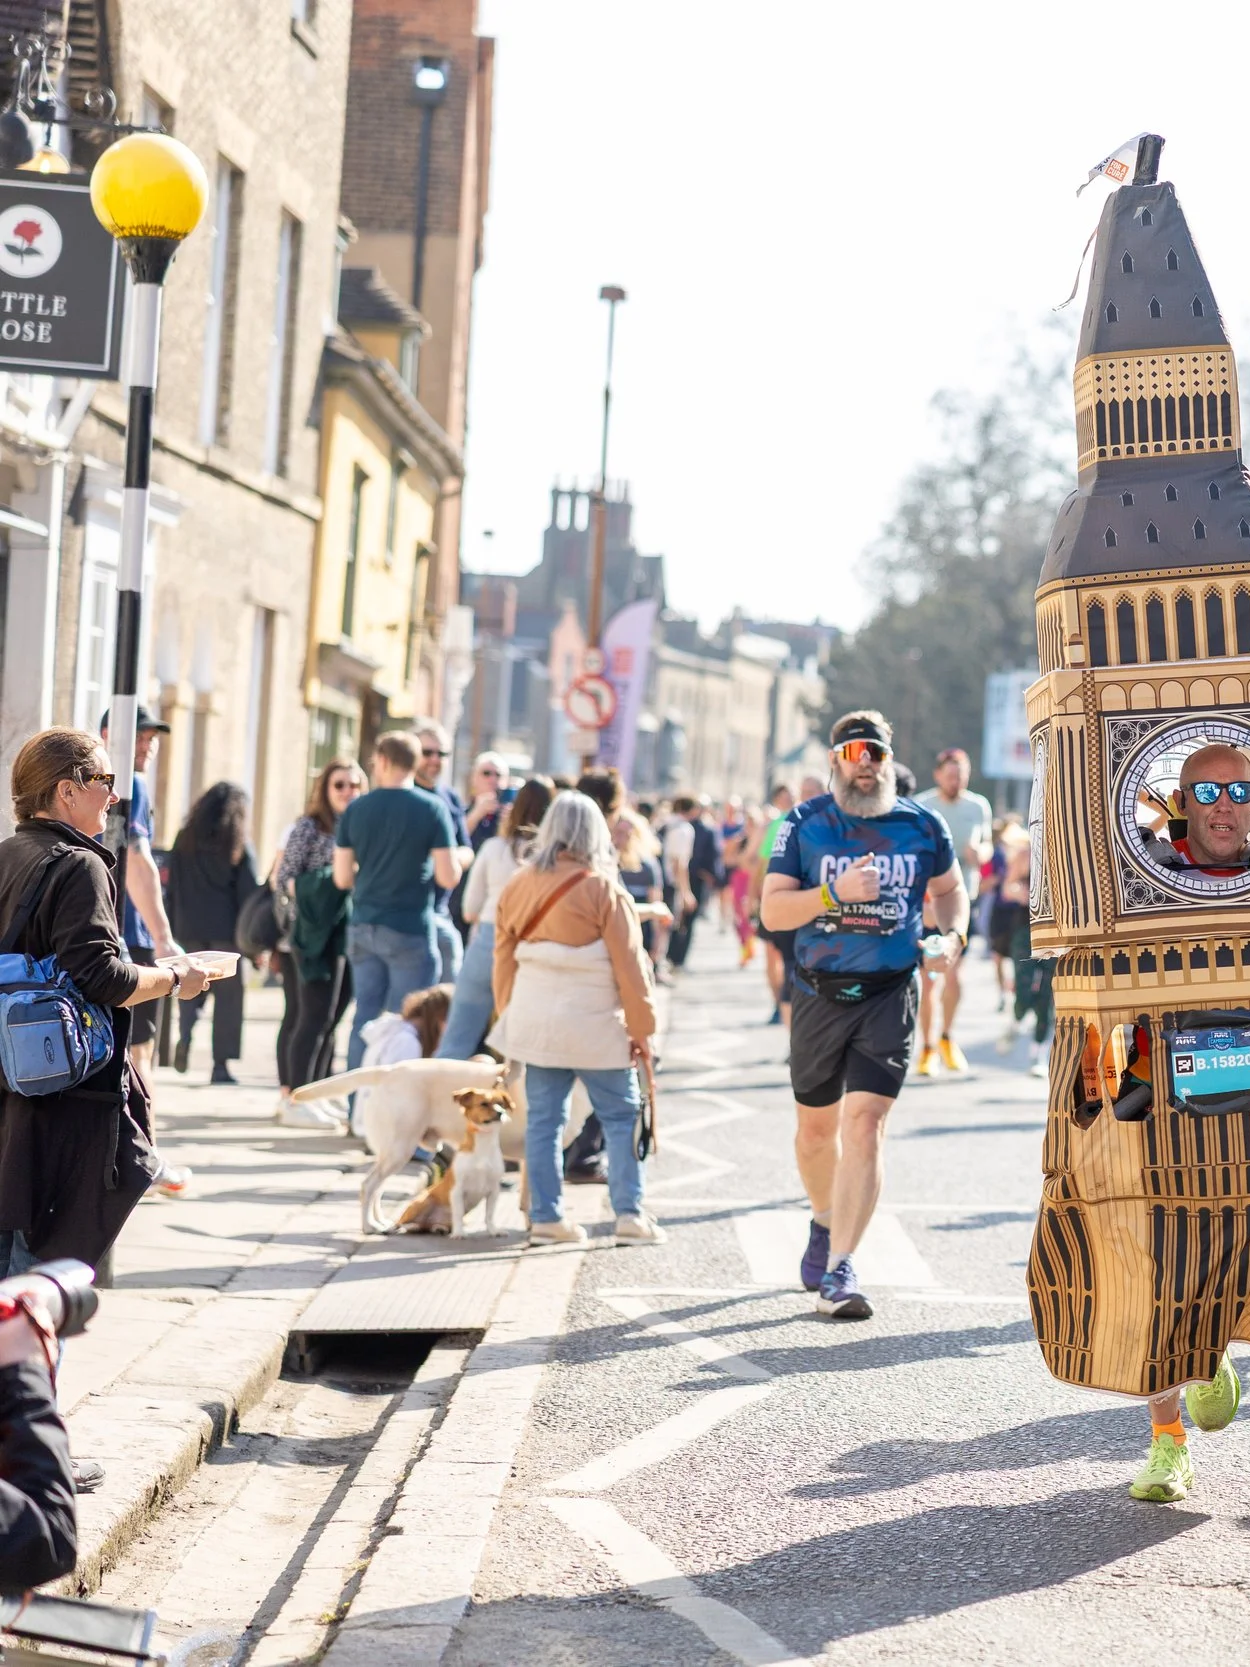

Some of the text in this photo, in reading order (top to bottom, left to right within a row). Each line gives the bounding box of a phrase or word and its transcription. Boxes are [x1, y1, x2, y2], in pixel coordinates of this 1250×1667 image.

[1107, 167, 1124, 180] CURE
[1110, 160, 1121, 170] FOR
[1, 291, 67, 317] TTLE
[0, 319, 52, 343] OSE
[820, 854, 917, 887] COBAT
[842, 917, 880, 926] MICHAEL
